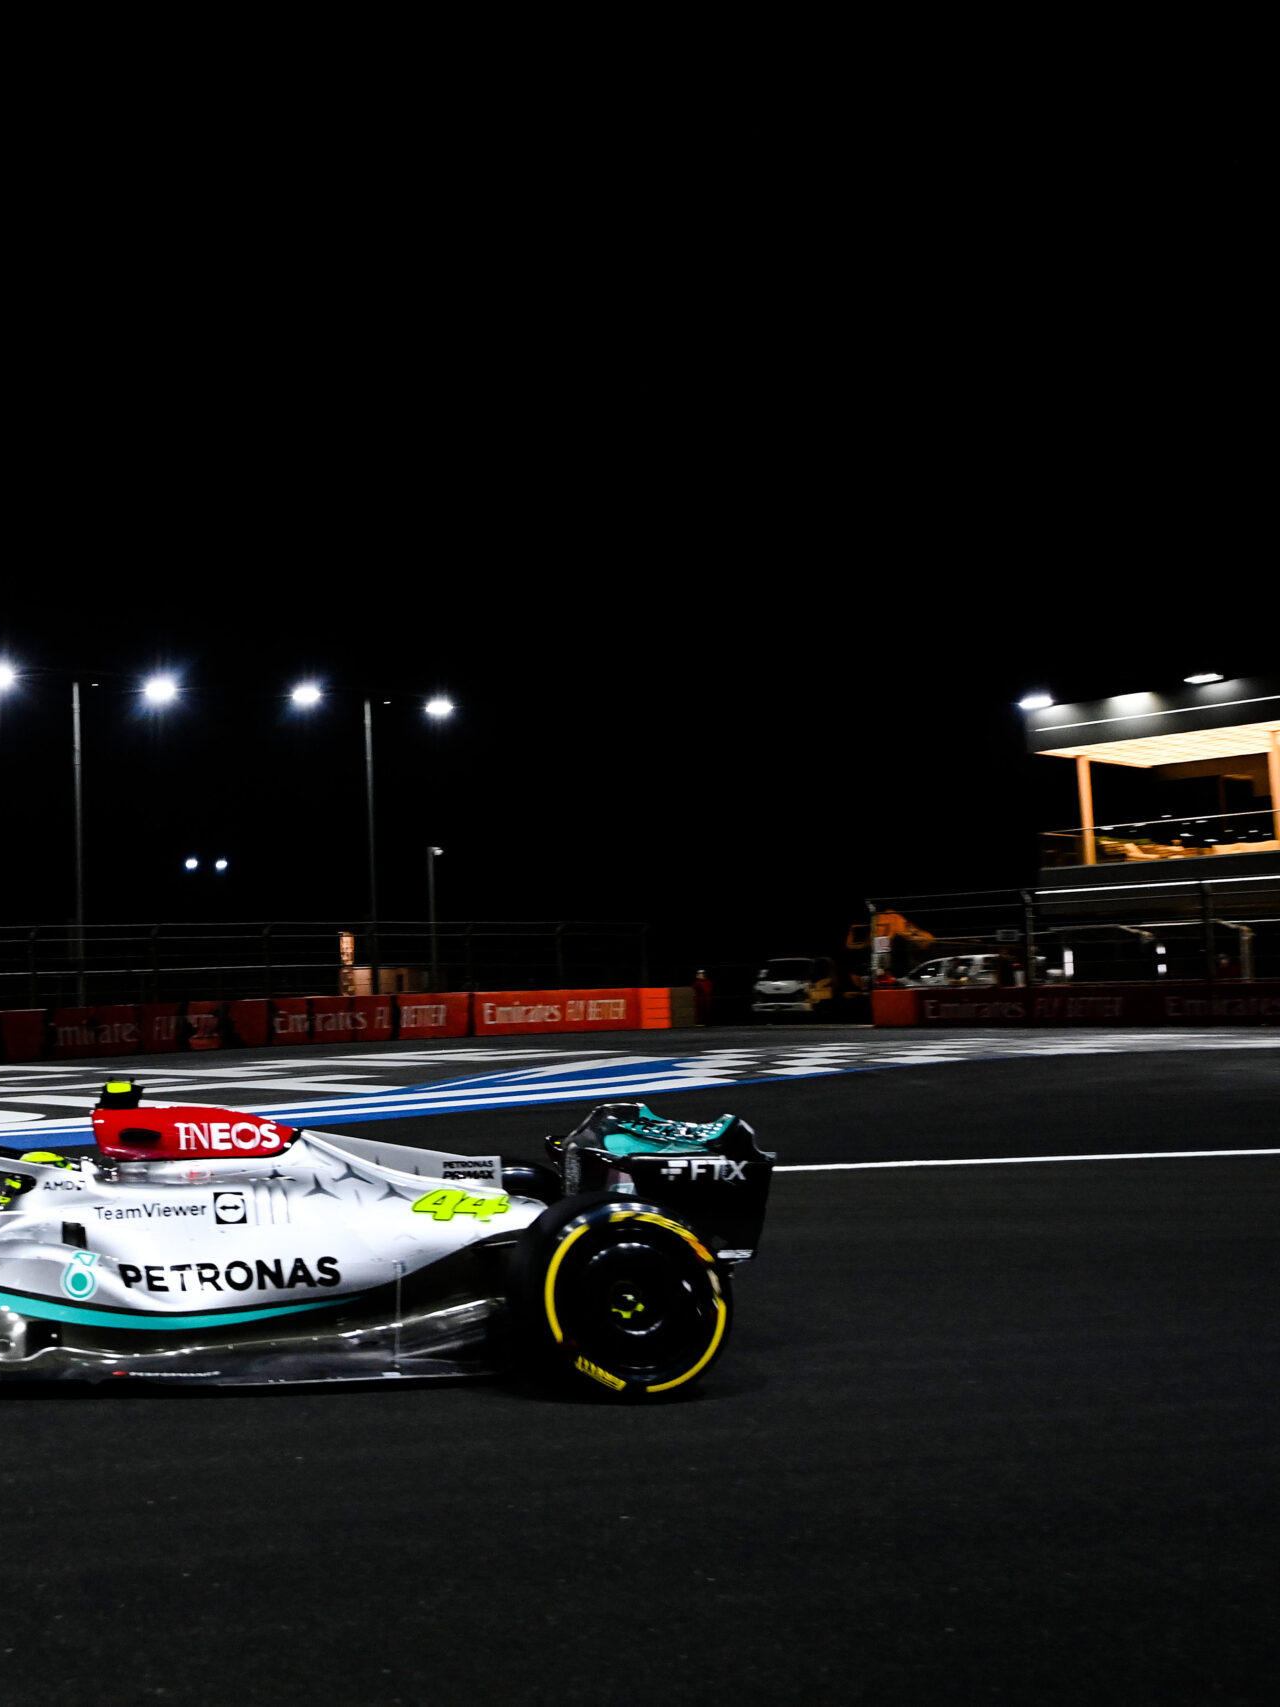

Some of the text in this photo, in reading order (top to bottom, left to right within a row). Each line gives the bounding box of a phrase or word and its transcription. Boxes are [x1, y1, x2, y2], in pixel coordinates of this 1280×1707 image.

[174, 1121, 281, 1151] INEOS
[442, 1160, 494, 1169] PETRONAS
[689, 1159, 748, 1182] FTX
[42, 1179, 73, 1191] AMD
[93, 1203, 208, 1221] TeamViewer
[412, 1189, 511, 1222] 44
[117, 1256, 342, 1293] PETRONAS
